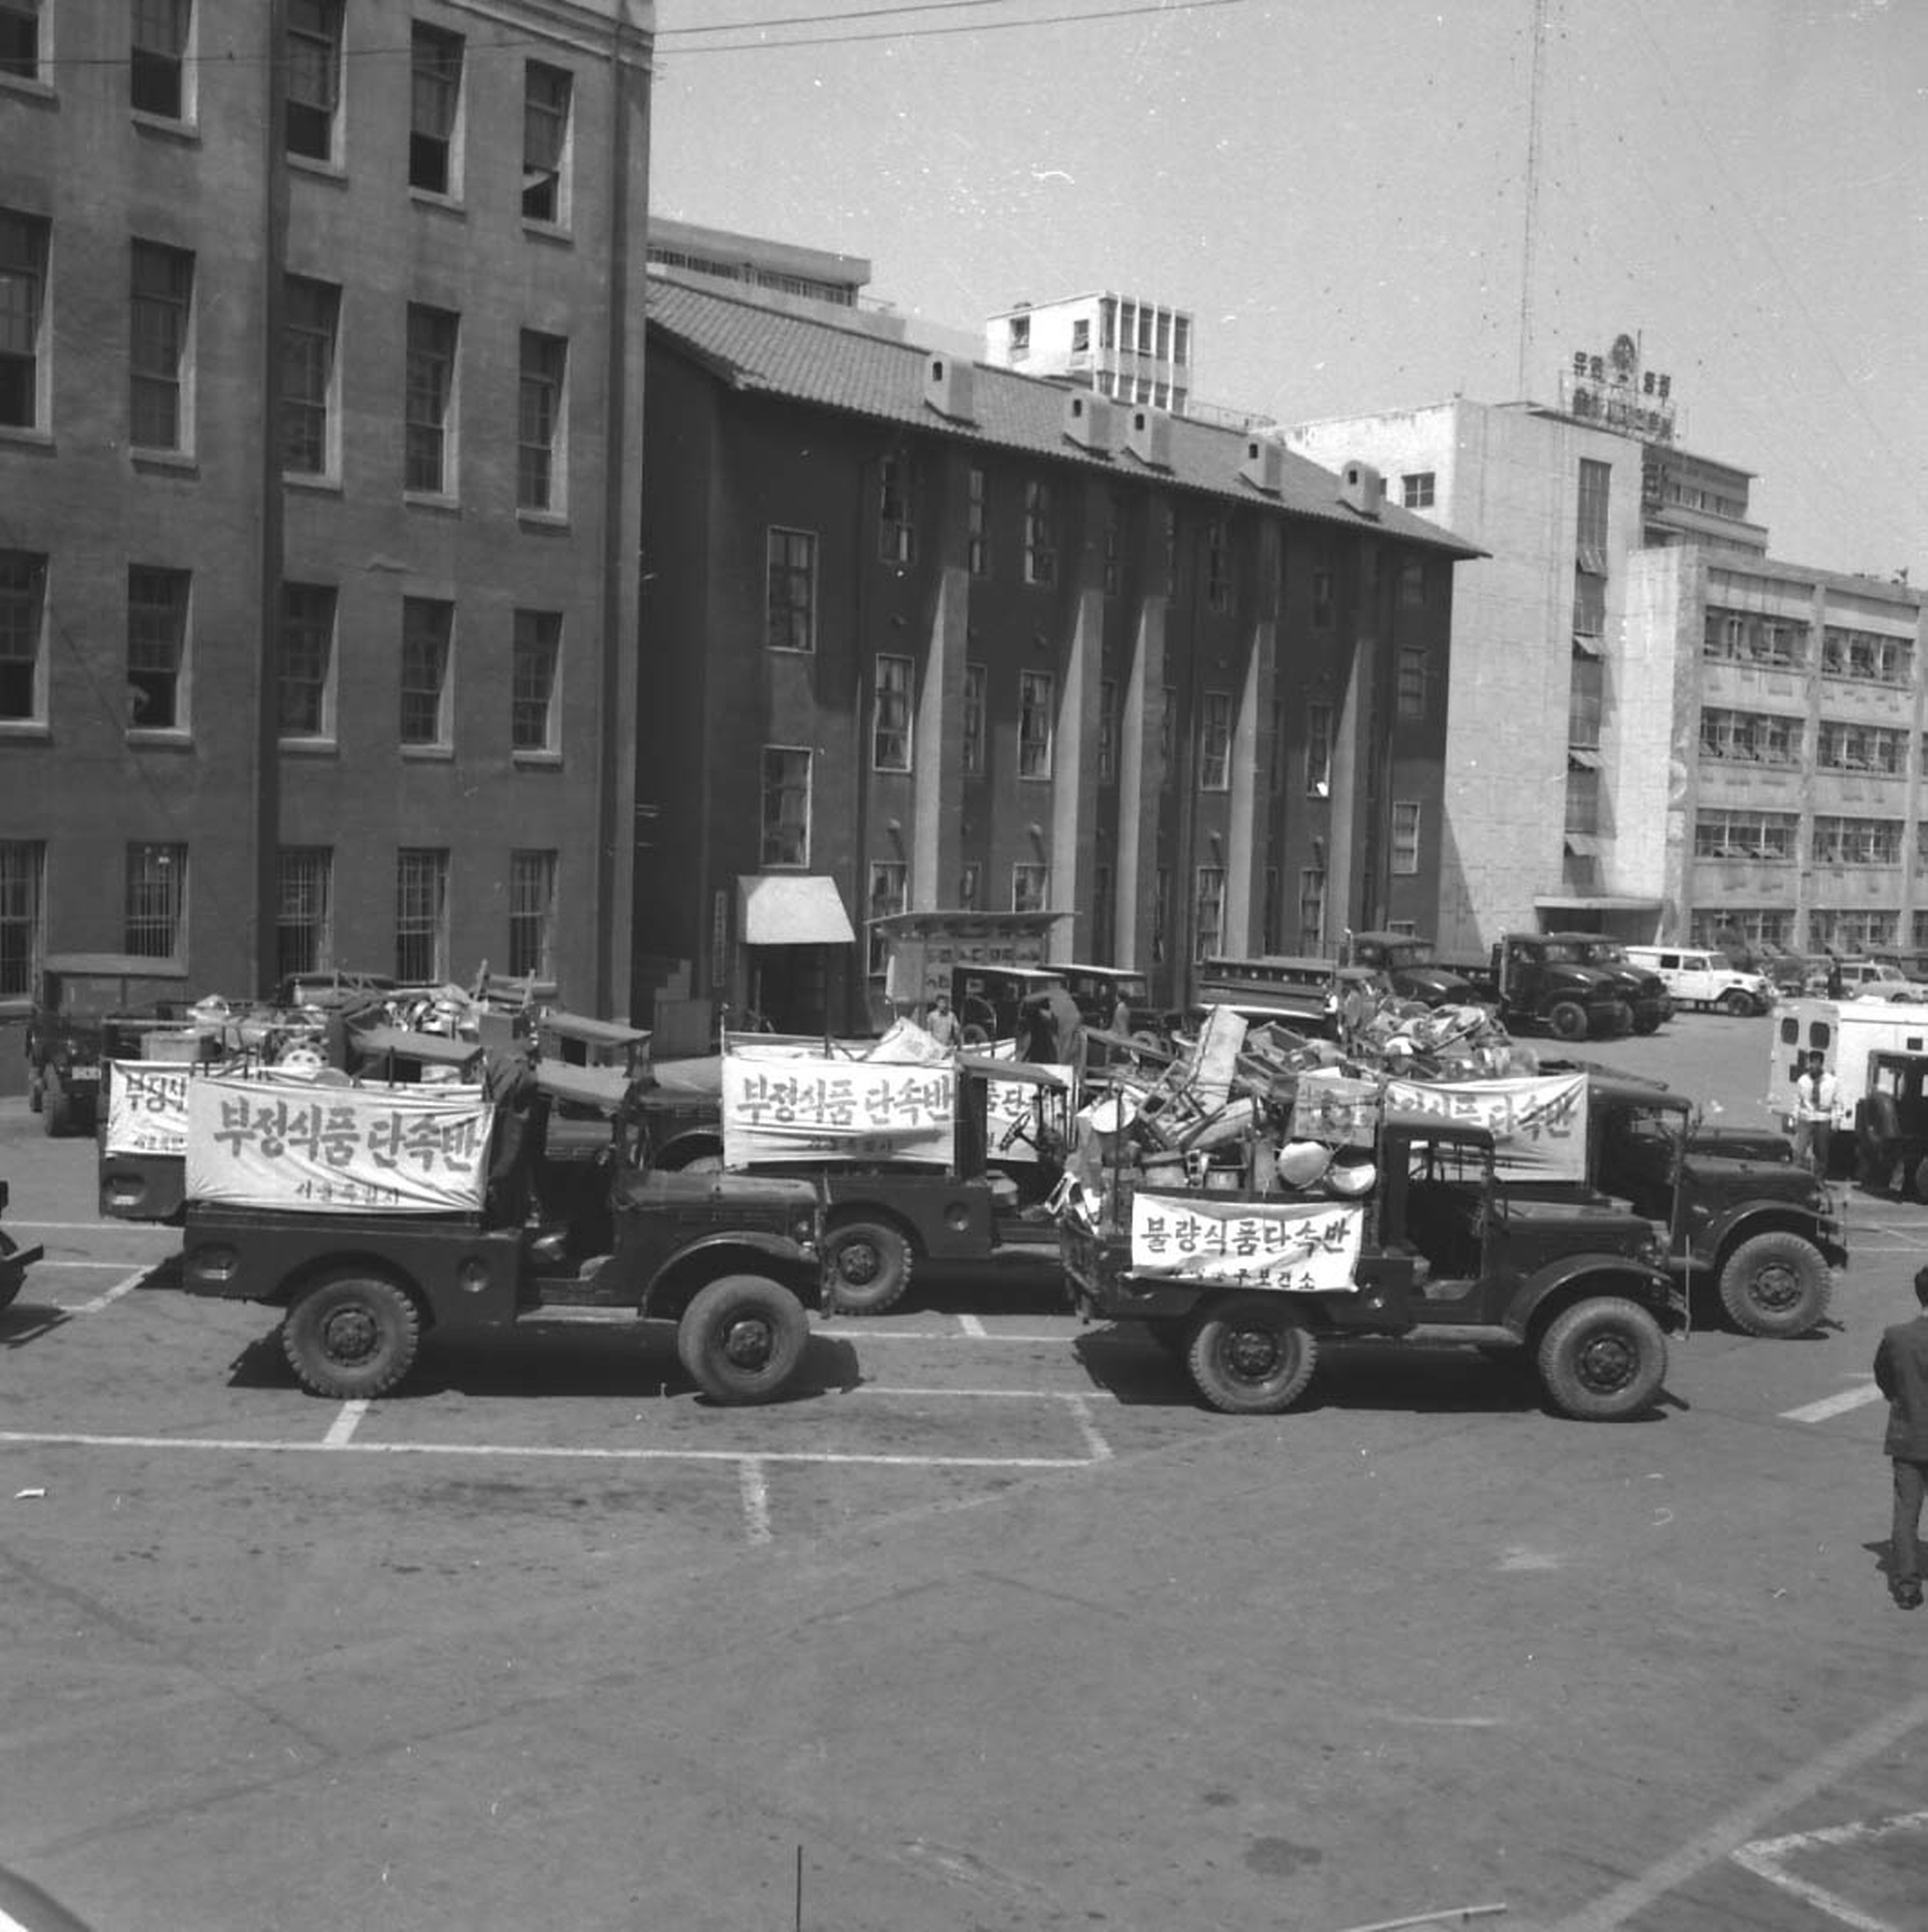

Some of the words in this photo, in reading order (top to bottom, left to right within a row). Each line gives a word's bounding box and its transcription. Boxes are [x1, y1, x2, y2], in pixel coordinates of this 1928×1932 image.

[737, 1074, 858, 1126] 부정식품
[865, 1074, 954, 1126] 단속반
[213, 1095, 362, 1167] 부정식품
[366, 1110, 481, 1173] 단속반
[1139, 1215, 1351, 1258] 불량식품단속반
